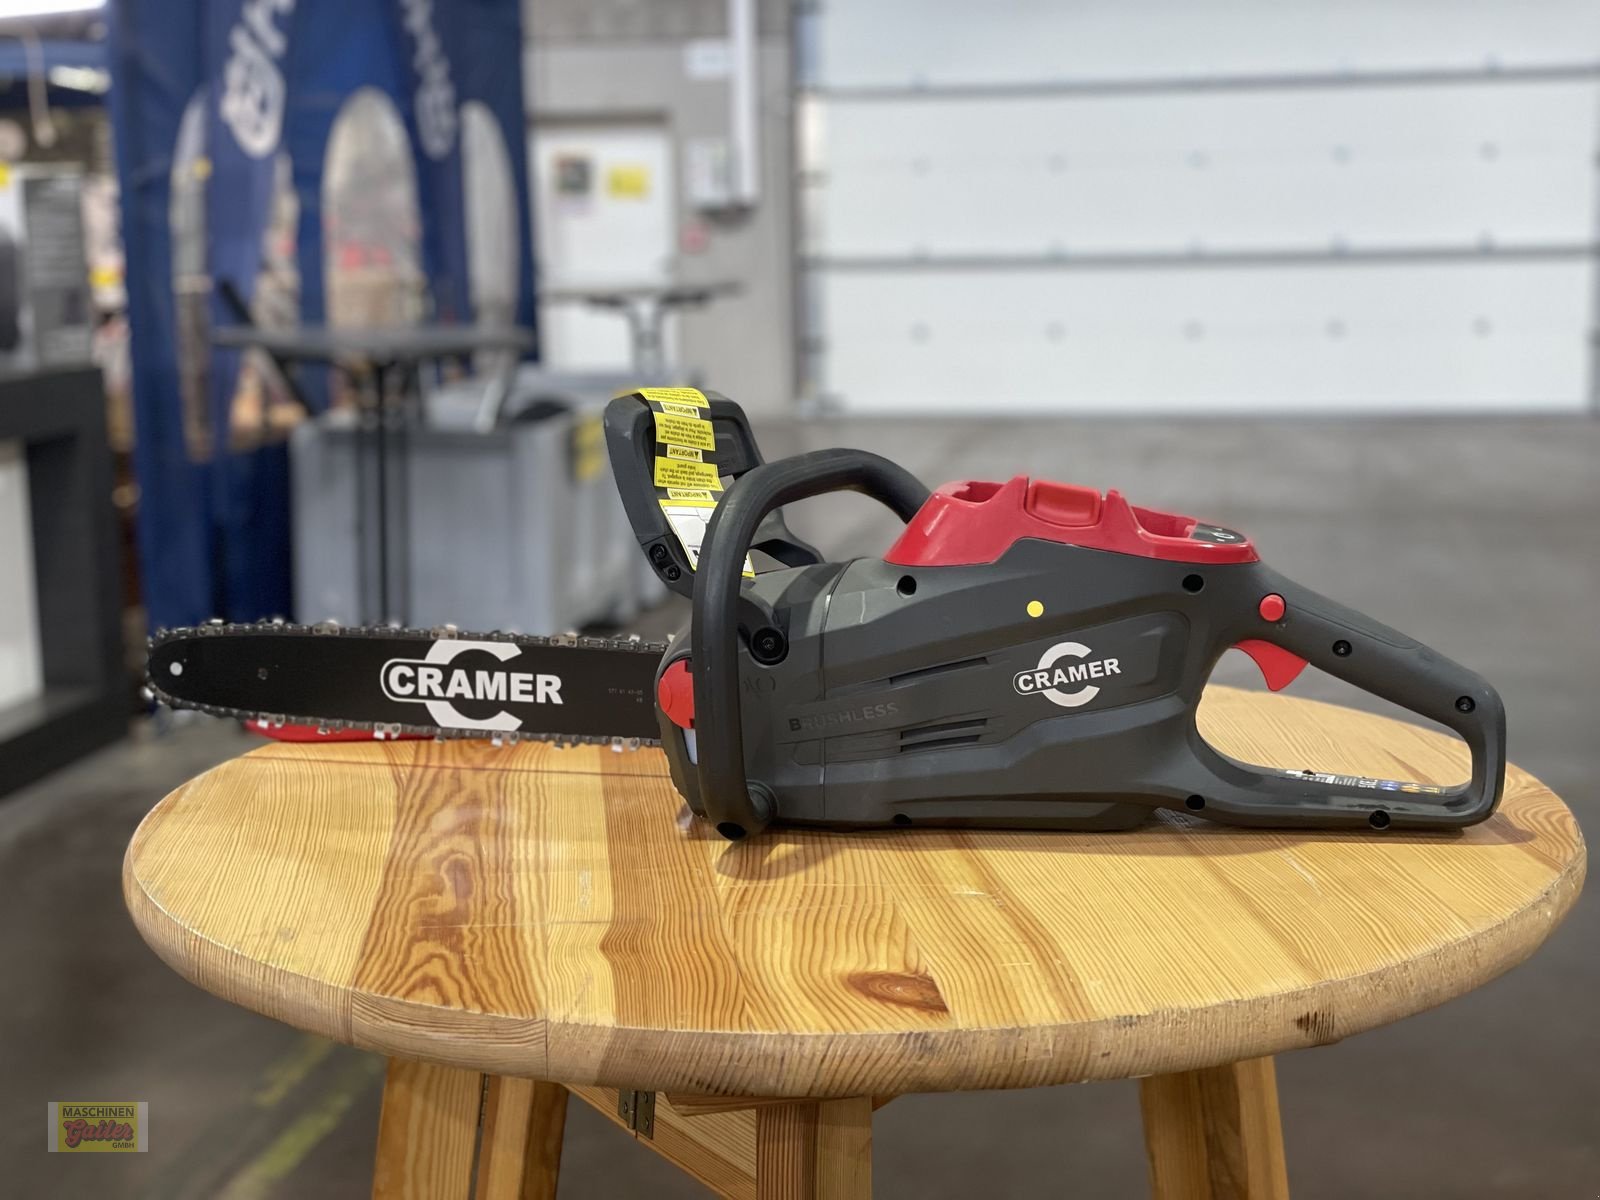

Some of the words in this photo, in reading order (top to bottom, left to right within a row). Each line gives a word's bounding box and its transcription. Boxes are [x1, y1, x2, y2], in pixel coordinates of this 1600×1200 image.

[669, 447, 693, 457] IMPORTANT
[670, 490, 702, 499] IMPORTANT
[387, 665, 563, 704] CRAMER
[1017, 657, 1121, 692] CRAMER
[789, 702, 899, 732] BRUSHLESS
